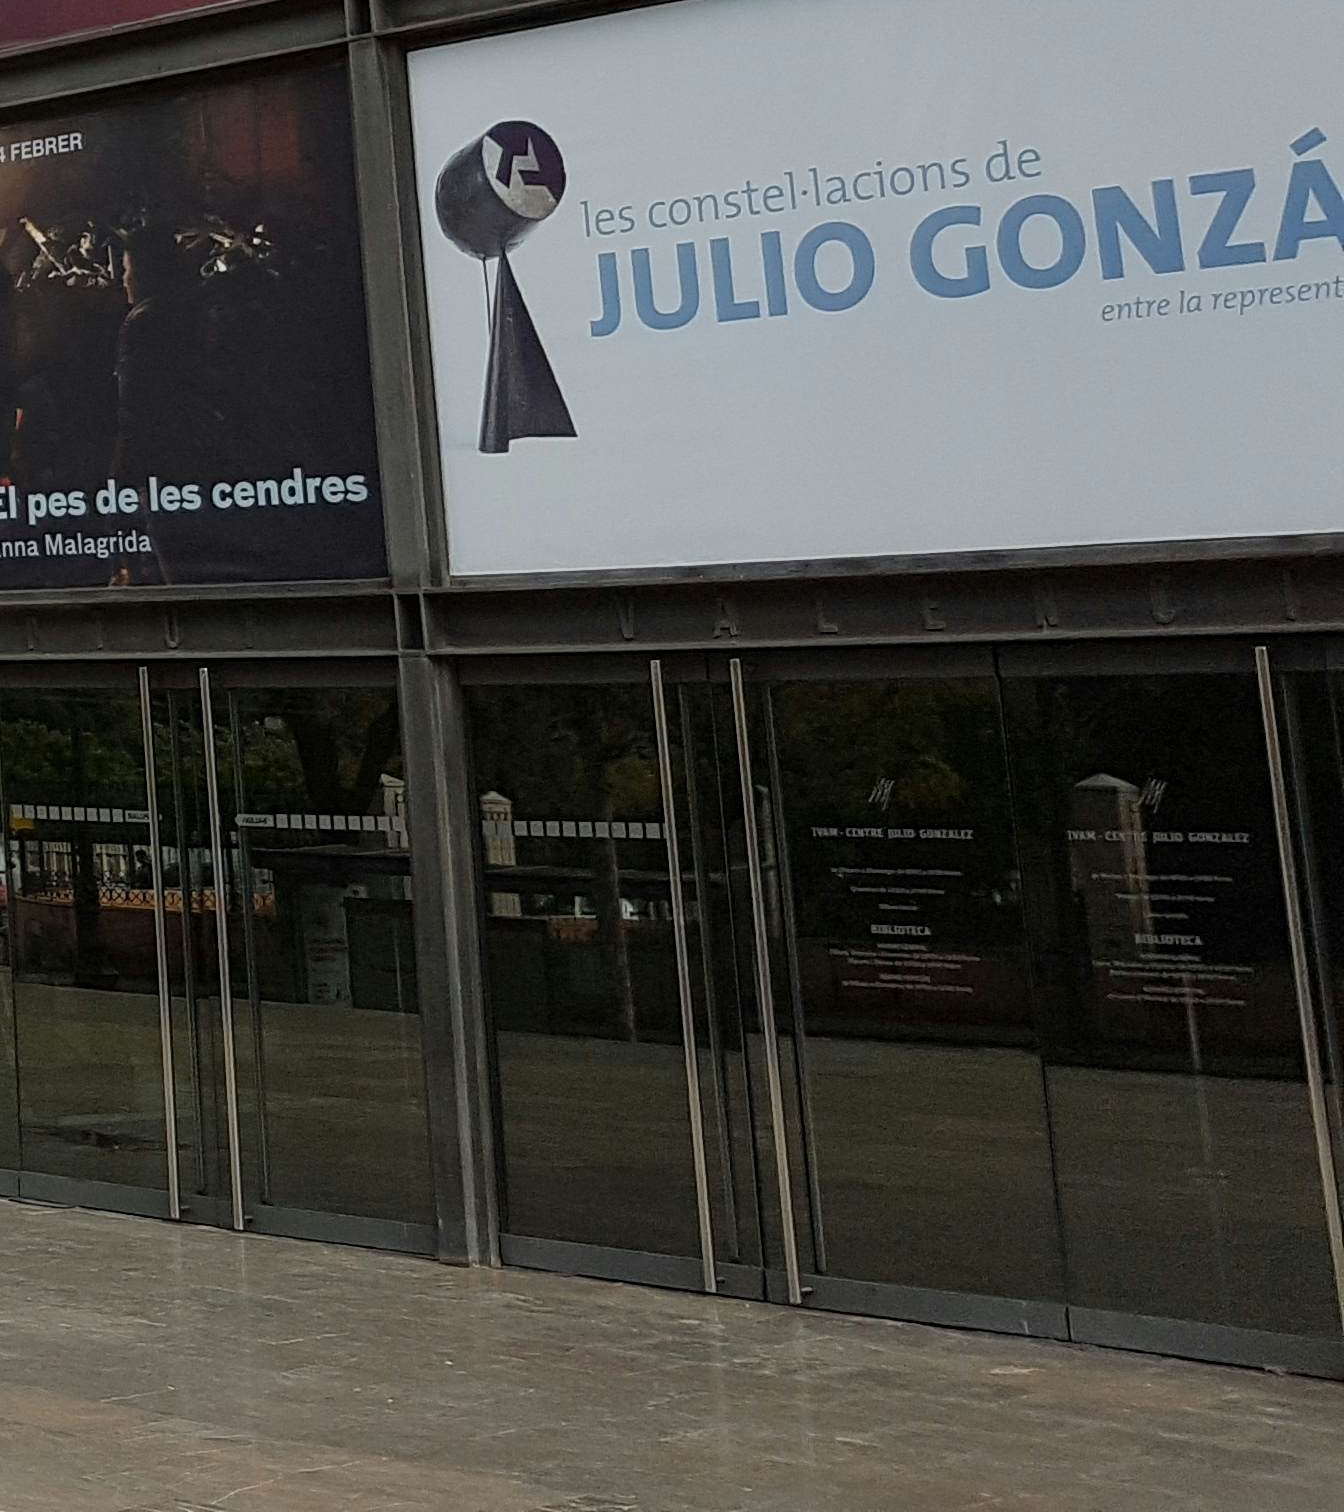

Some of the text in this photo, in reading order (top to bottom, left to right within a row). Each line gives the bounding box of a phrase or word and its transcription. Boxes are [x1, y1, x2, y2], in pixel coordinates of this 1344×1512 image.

[10, 132, 84, 162] FEBRER
[580, 140, 1042, 238] les constel·lacions de
[590, 126, 1344, 338] JULIO GONZÁ
[1101, 296, 1170, 322] entre
[1179, 290, 1203, 314] la
[27, 490, 87, 526] pes
[96, 479, 139, 515] de
[149, 476, 202, 513] les
[211, 467, 368, 510] cendres
[44, 530, 152, 559] Malagrida
